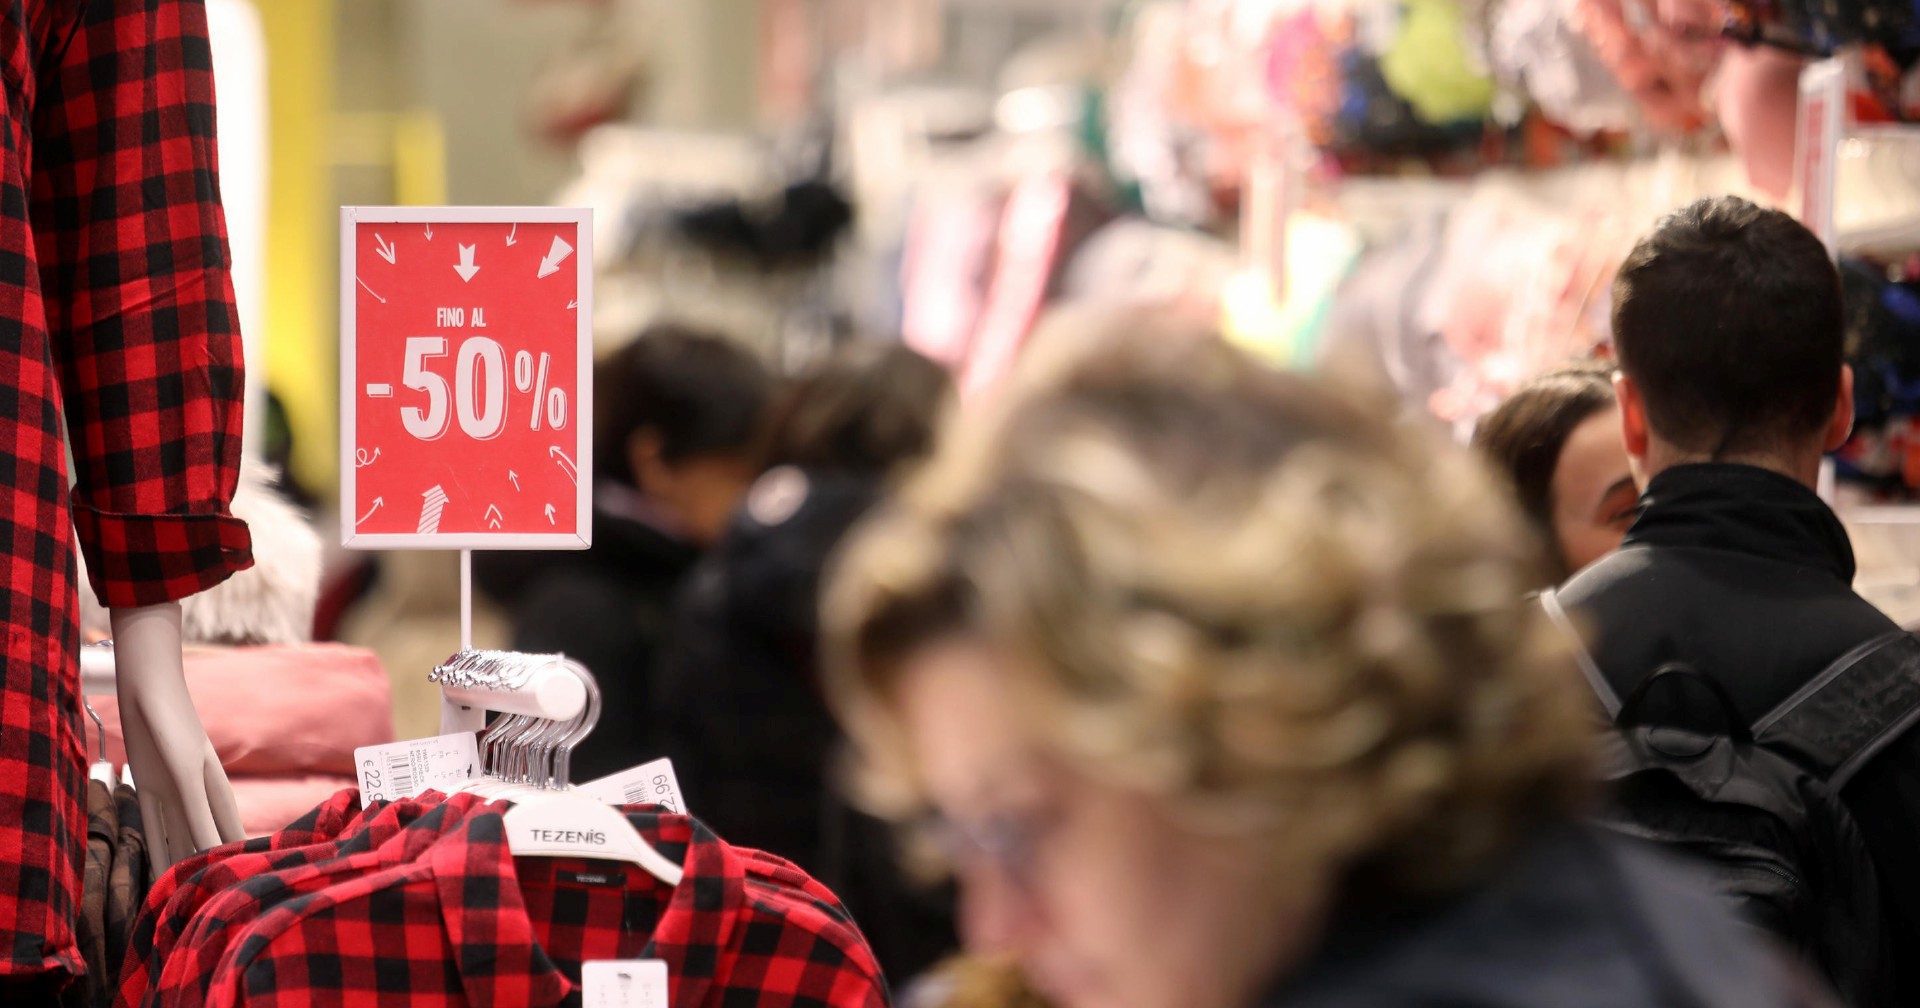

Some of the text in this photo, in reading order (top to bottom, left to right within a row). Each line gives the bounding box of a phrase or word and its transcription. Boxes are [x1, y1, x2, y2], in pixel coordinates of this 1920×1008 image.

[436, 307, 487, 328] FINO AL
[366, 336, 568, 441] -50%
[363, 759, 384, 802] € 22,9
[417, 763, 425, 784] CHECK
[652, 774, 678, 814] 2,99
